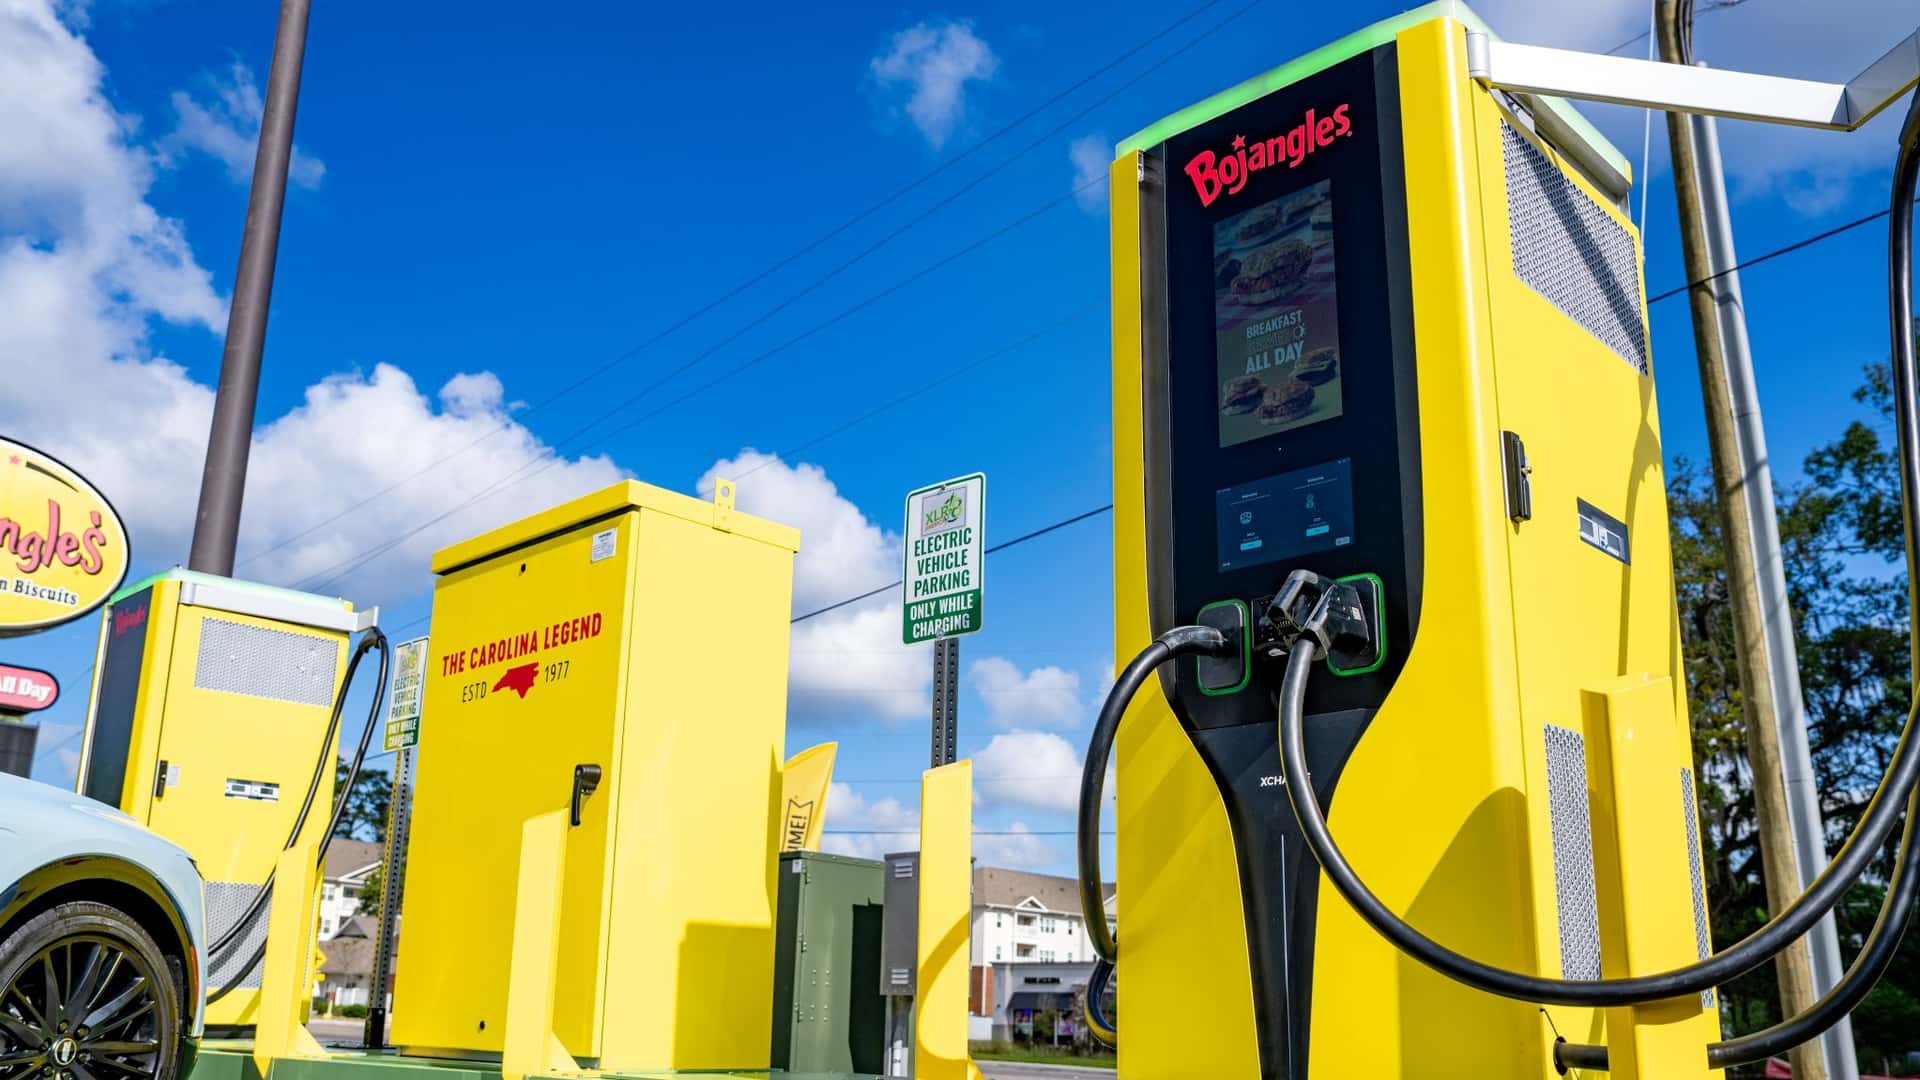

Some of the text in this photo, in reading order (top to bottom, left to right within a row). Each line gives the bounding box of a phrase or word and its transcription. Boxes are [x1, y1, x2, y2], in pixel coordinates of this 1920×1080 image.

[1184, 103, 1352, 208] Bojangles
[1246, 309, 1303, 339] BREAKFAST
[1245, 341, 1304, 375] ALL DAY
[914, 528, 972, 557] ELECTRIC
[917, 549, 968, 577] VEHICLE
[15, 579, 77, 605] Biscuits
[914, 569, 970, 598] PARKING
[910, 593, 974, 621] ONLY WHILE
[912, 613, 970, 639] CHARGING
[443, 612, 602, 677] THE CAROLINA LEGEND
[545, 660, 570, 682] 1977
[18, 678, 51, 700] Day
[462, 681, 487, 703] ESTD
[391, 702, 417, 719] PARKING
